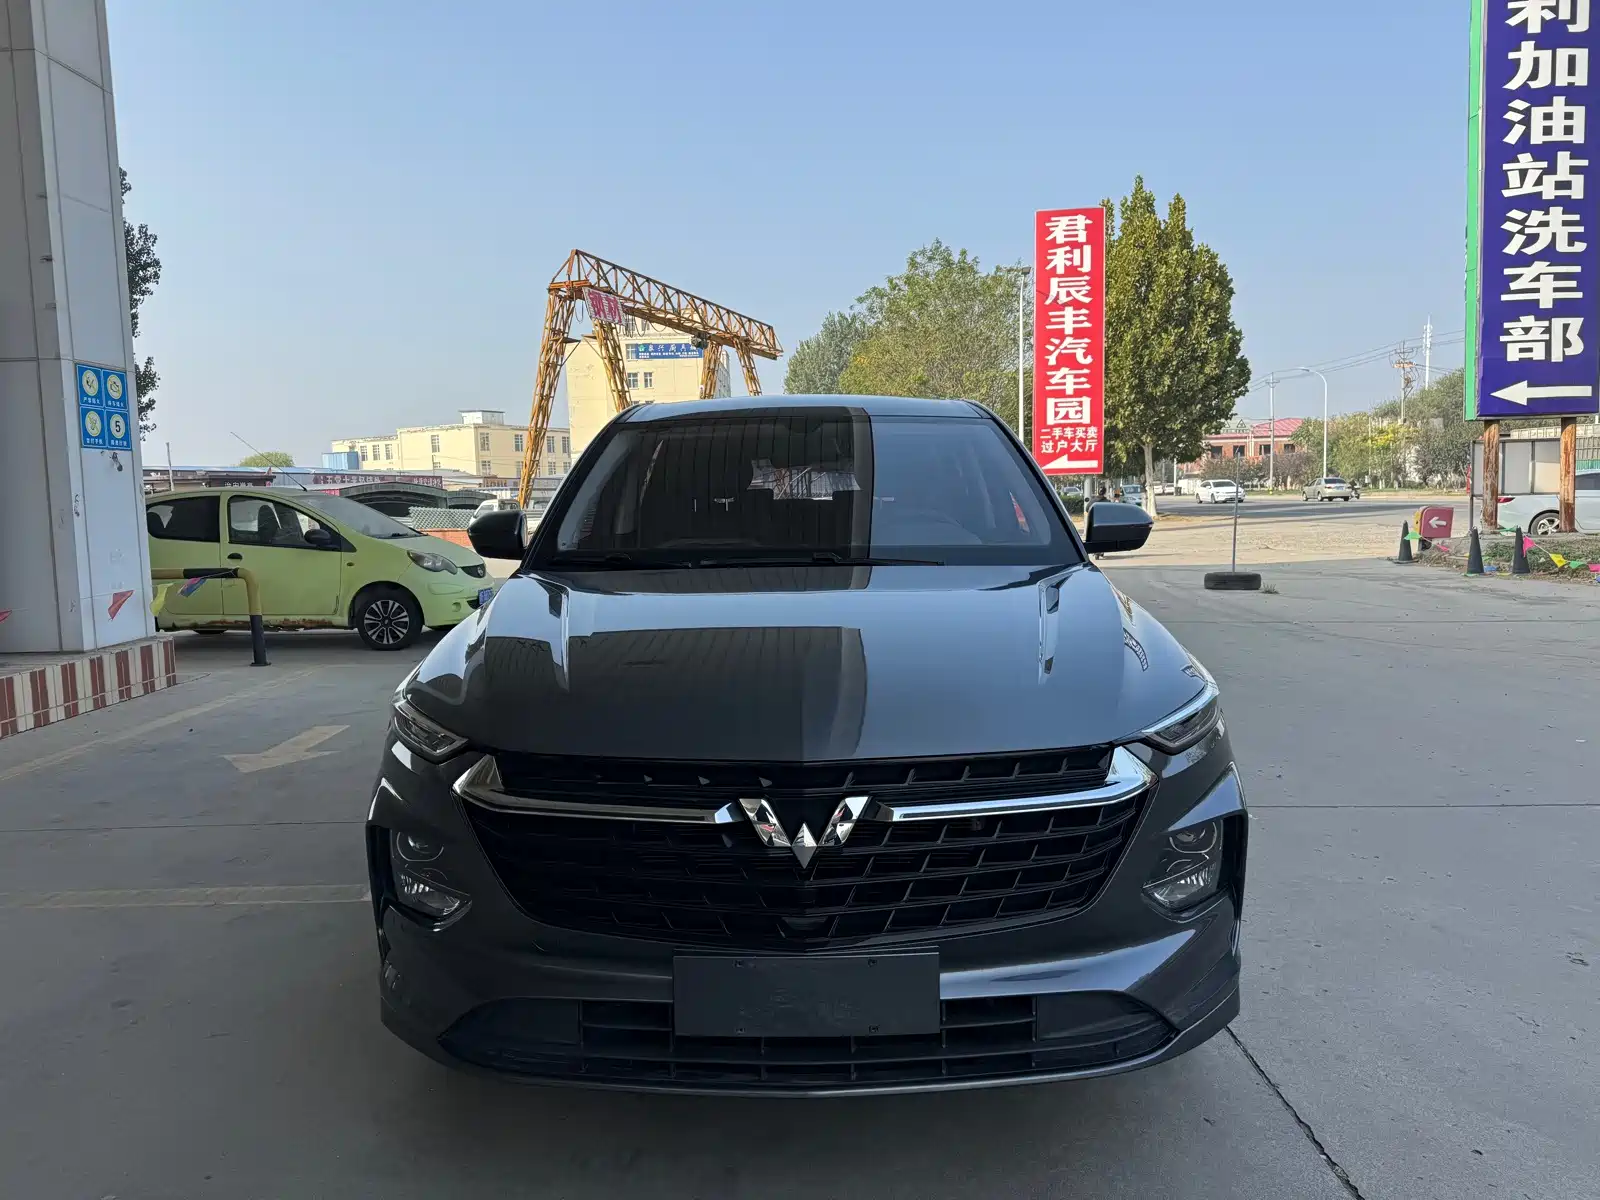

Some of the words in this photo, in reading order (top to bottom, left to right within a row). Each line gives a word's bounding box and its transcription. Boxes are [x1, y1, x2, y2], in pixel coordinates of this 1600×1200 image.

[1500, 0, 1590, 363] 利加油站洗车部
[1045, 213, 1094, 426] 君利辰丰汽车园
[115, 420, 121, 433] 5
[1040, 427, 1098, 440] 二手车买卖
[1040, 439, 1098, 453] 过户大厅
